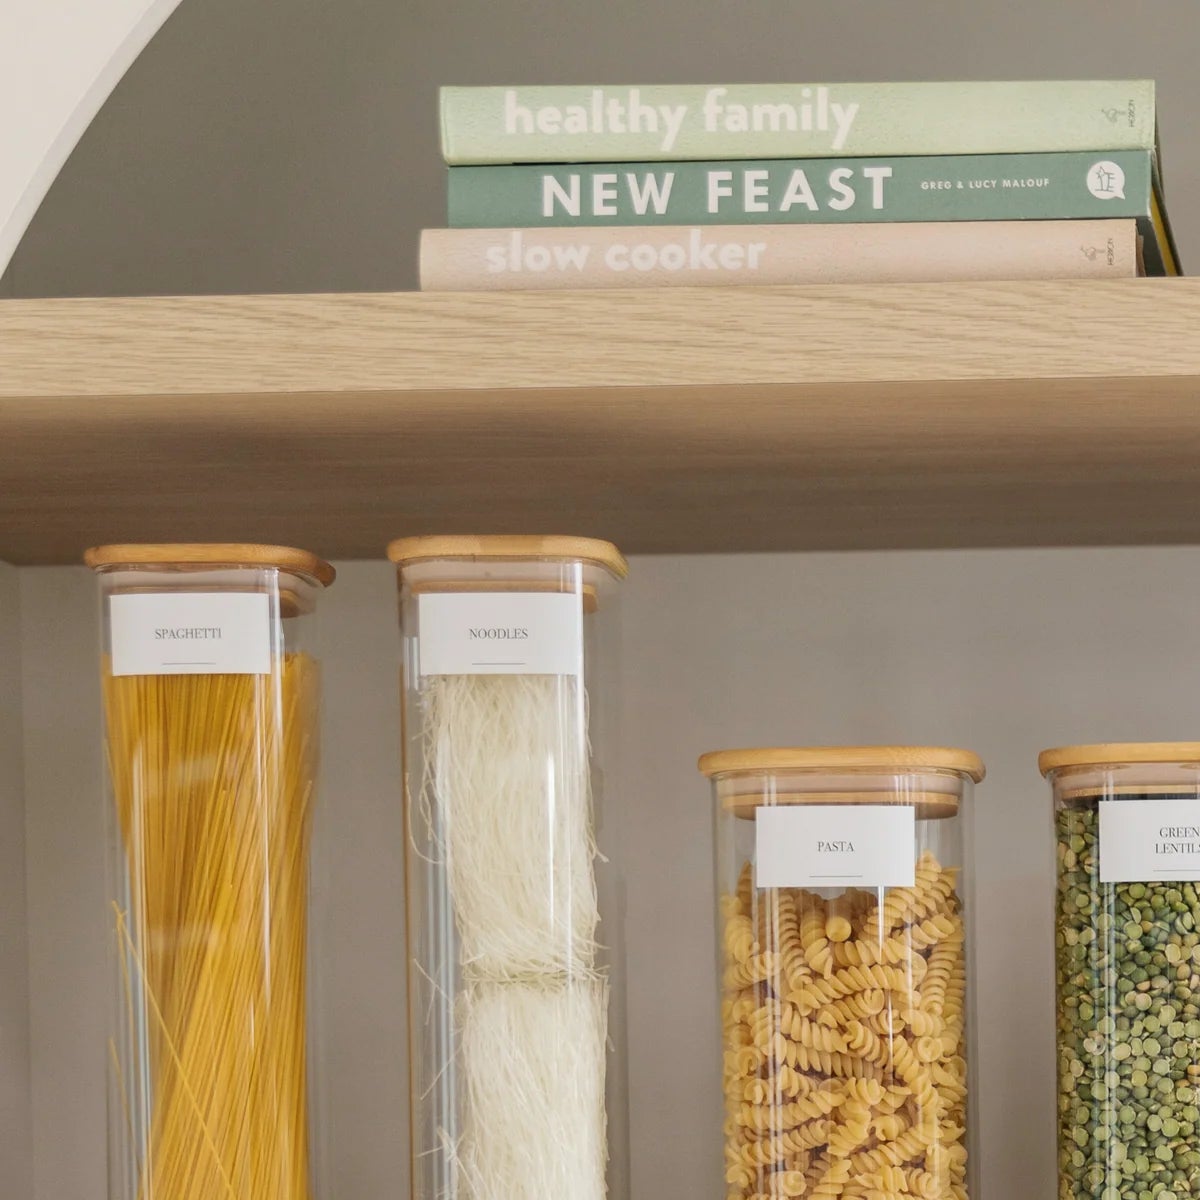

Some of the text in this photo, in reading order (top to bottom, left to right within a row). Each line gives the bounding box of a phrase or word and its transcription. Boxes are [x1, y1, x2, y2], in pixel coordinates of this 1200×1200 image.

[504, 87, 859, 151] healthy family
[920, 178, 1050, 190] GREG & LUCY MALOUF
[543, 167, 893, 217] NEW FEAST
[485, 229, 766, 272] slow cooker
[154, 628, 222, 640] SPAGHETTI
[468, 628, 529, 640] NOODLES
[1158, 826, 1200, 840] GREEN
[817, 841, 855, 853] PASTA
